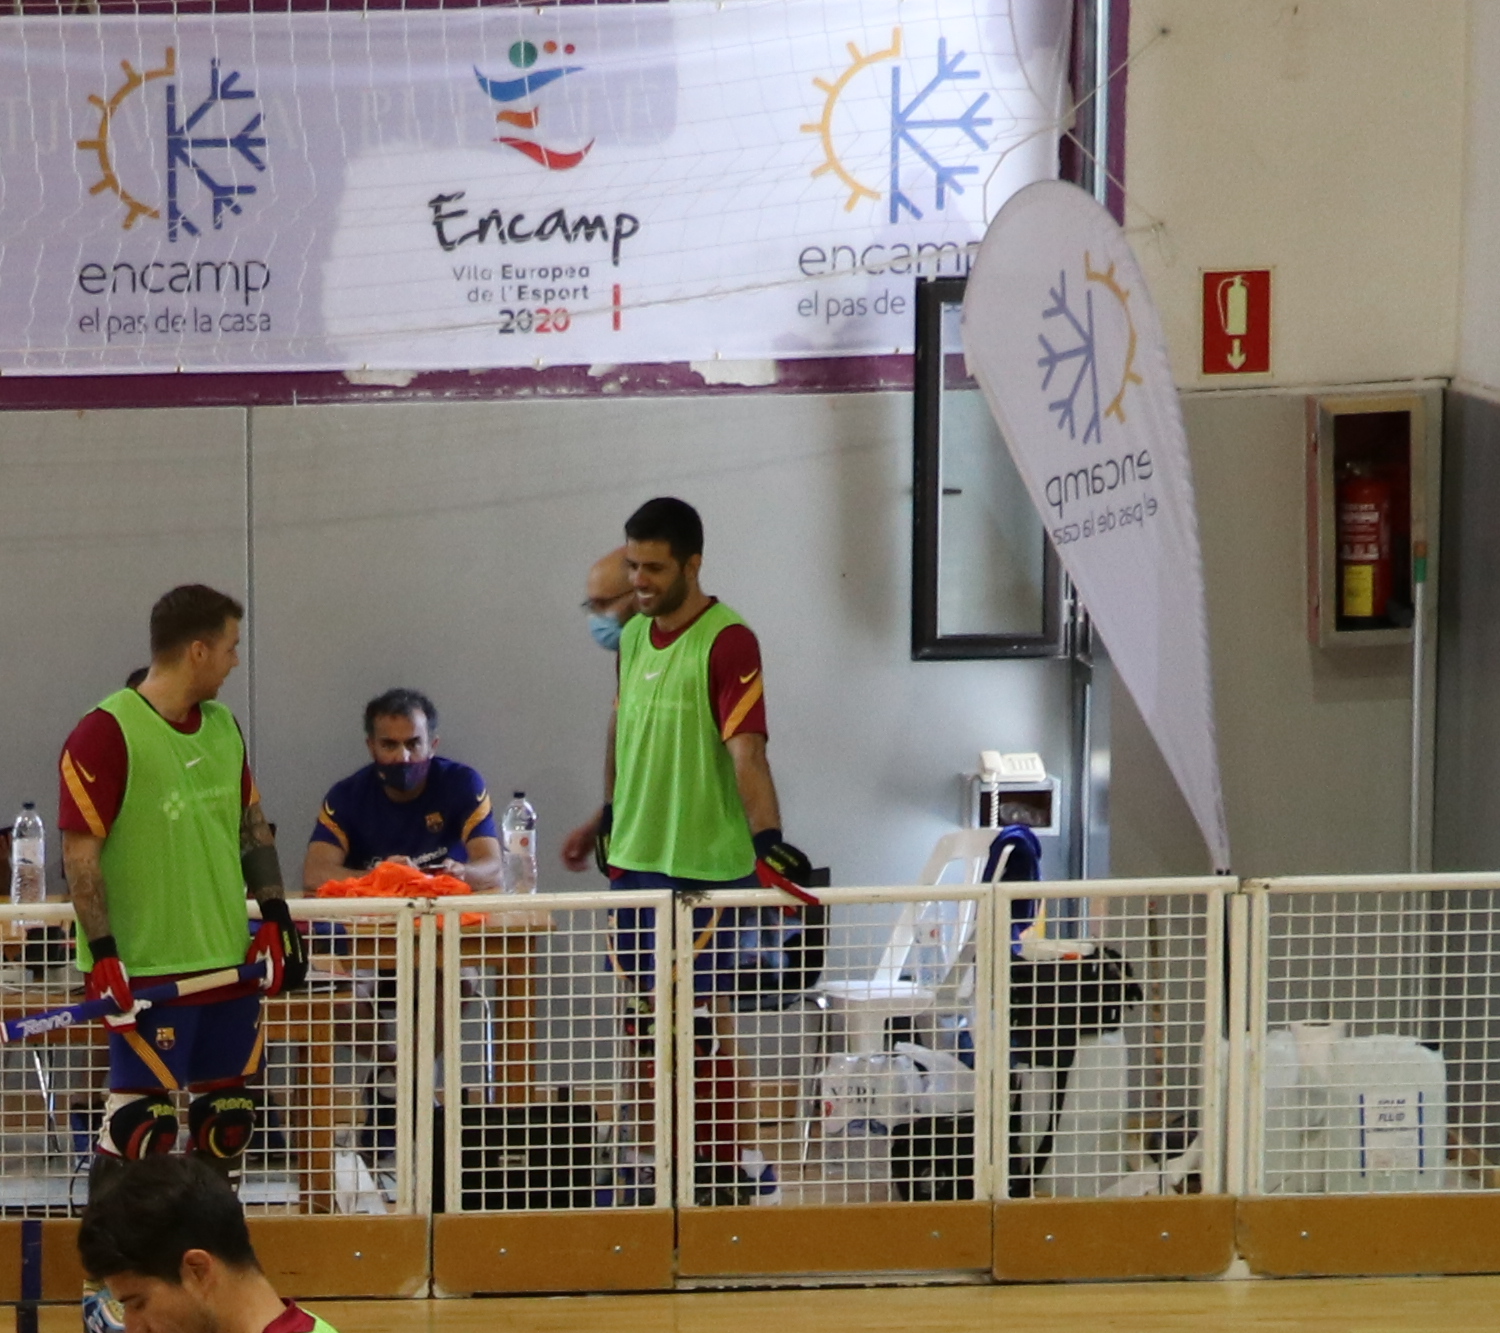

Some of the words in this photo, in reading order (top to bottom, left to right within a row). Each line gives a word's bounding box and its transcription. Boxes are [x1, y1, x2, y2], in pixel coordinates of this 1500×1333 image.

[428, 191, 641, 267] Encamp
[79, 260, 271, 307] encamp
[452, 265, 493, 282] Vila
[501, 263, 591, 282] Europea
[466, 286, 494, 303] de
[798, 290, 818, 317] el
[826, 298, 867, 325] pas
[873, 288, 906, 316] de
[79, 307, 100, 333] el
[107, 314, 148, 343] pas
[155, 306, 187, 334] de
[194, 306, 213, 333] la
[219, 312, 272, 333] casa
[498, 306, 572, 335] 2020
[15, 1010, 74, 1038] Reno
